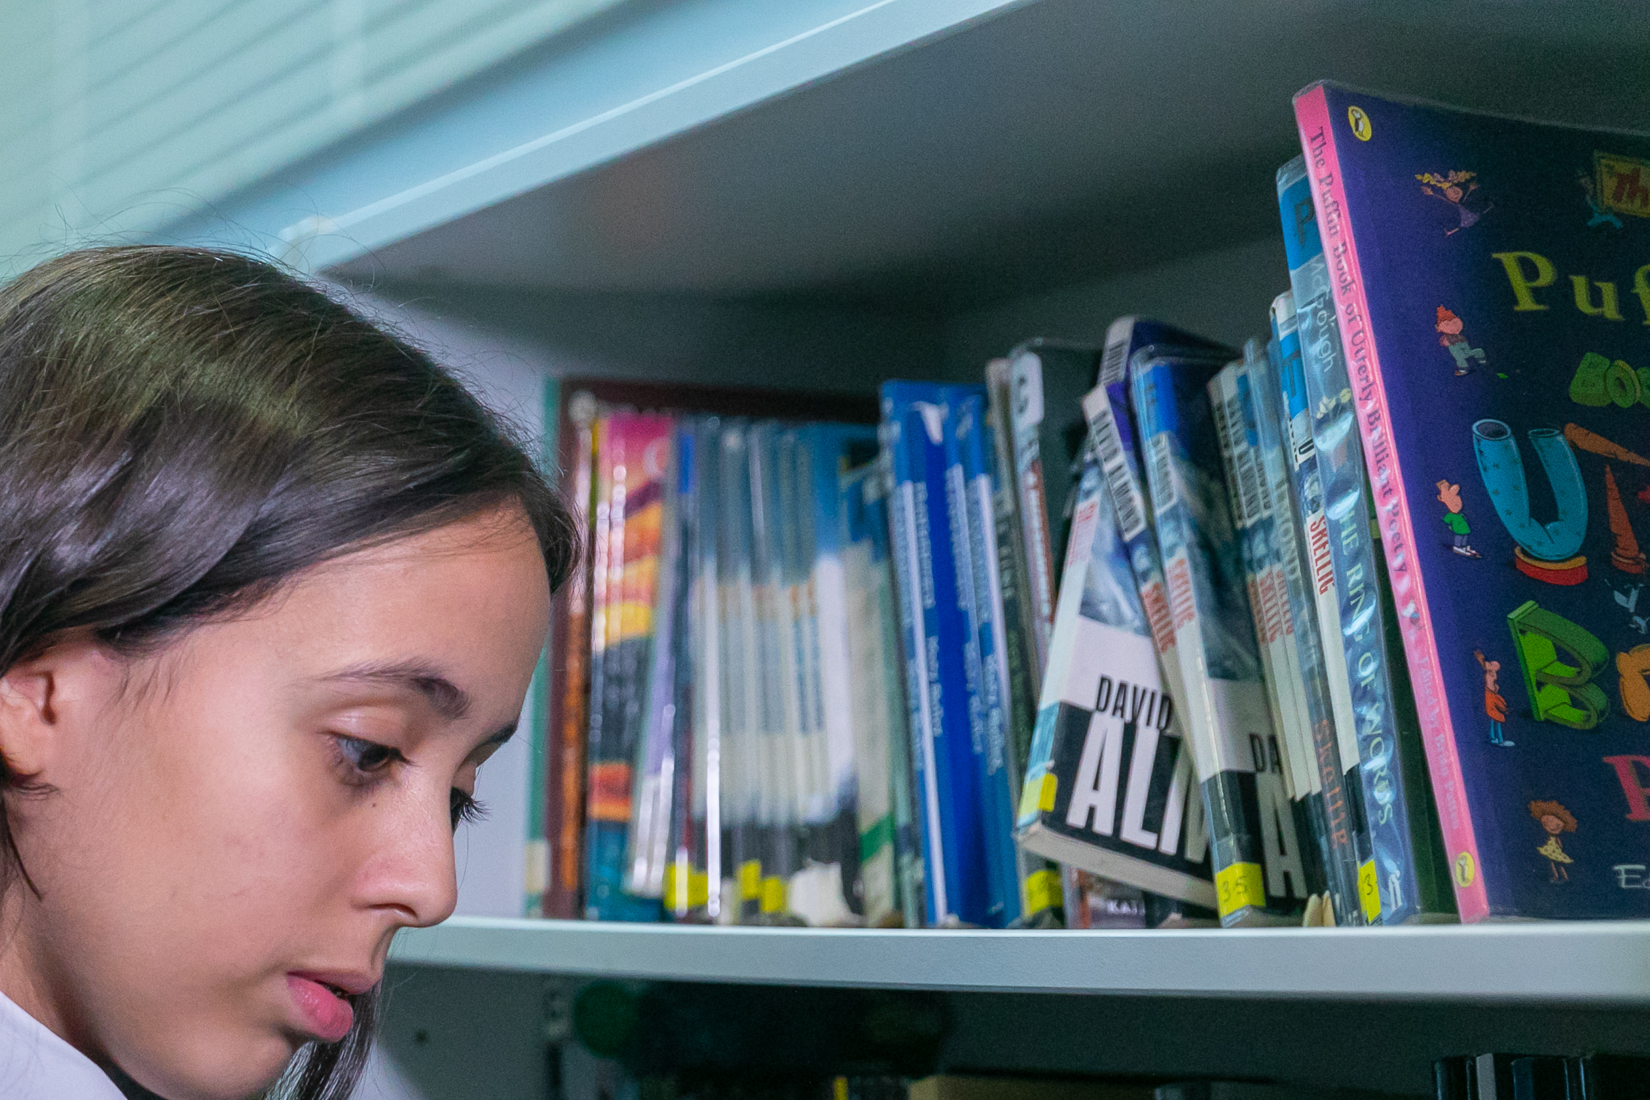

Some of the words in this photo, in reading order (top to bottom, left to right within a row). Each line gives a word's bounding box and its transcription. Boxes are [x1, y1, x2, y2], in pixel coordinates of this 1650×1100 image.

[1308, 126, 1330, 169] The
[1319, 172, 1344, 237] Puffin
[1332, 241, 1355, 296] Book
[1345, 301, 1362, 324] of
[1346, 329, 1376, 403] Utterly
[1366, 409, 1395, 497] Brilliant
[1309, 514, 1335, 596] SKELLIG
[1346, 562, 1371, 642] RING
[1096, 672, 1174, 731] DAVID
[1357, 651, 1377, 691] OF
[1364, 702, 1393, 825] WORDS
